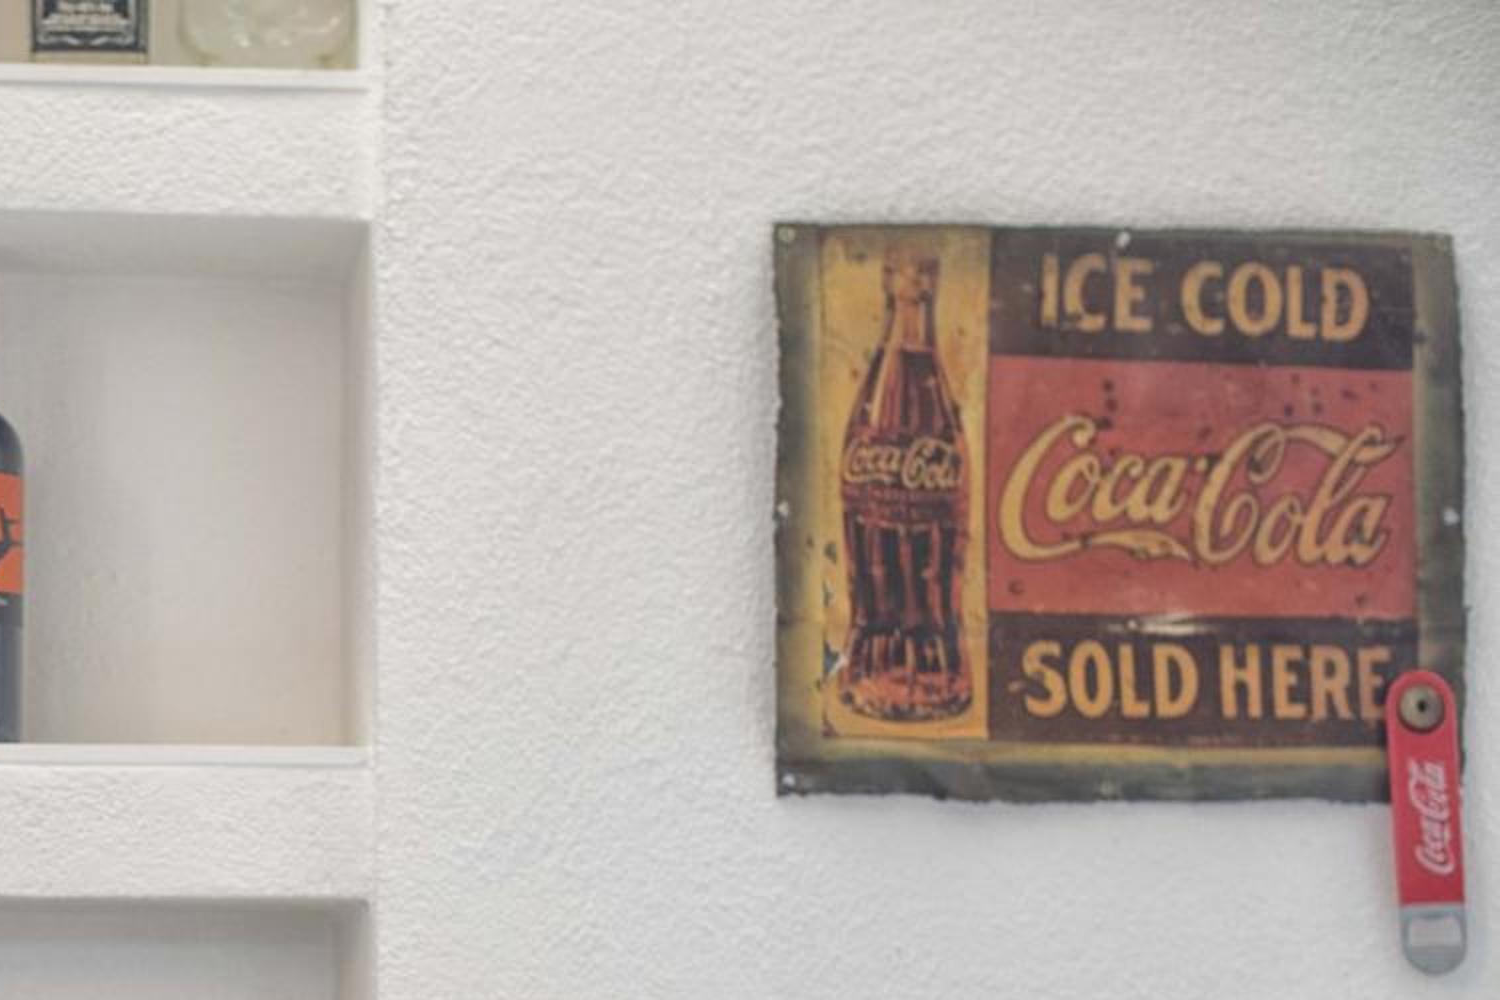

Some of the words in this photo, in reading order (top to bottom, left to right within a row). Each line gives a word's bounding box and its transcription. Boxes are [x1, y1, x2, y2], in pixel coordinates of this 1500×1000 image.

[1040, 253, 1154, 334] ICE
[1181, 261, 1370, 342] COLD
[1021, 640, 1199, 720] SOLD
[1219, 642, 1392, 723] HERE
